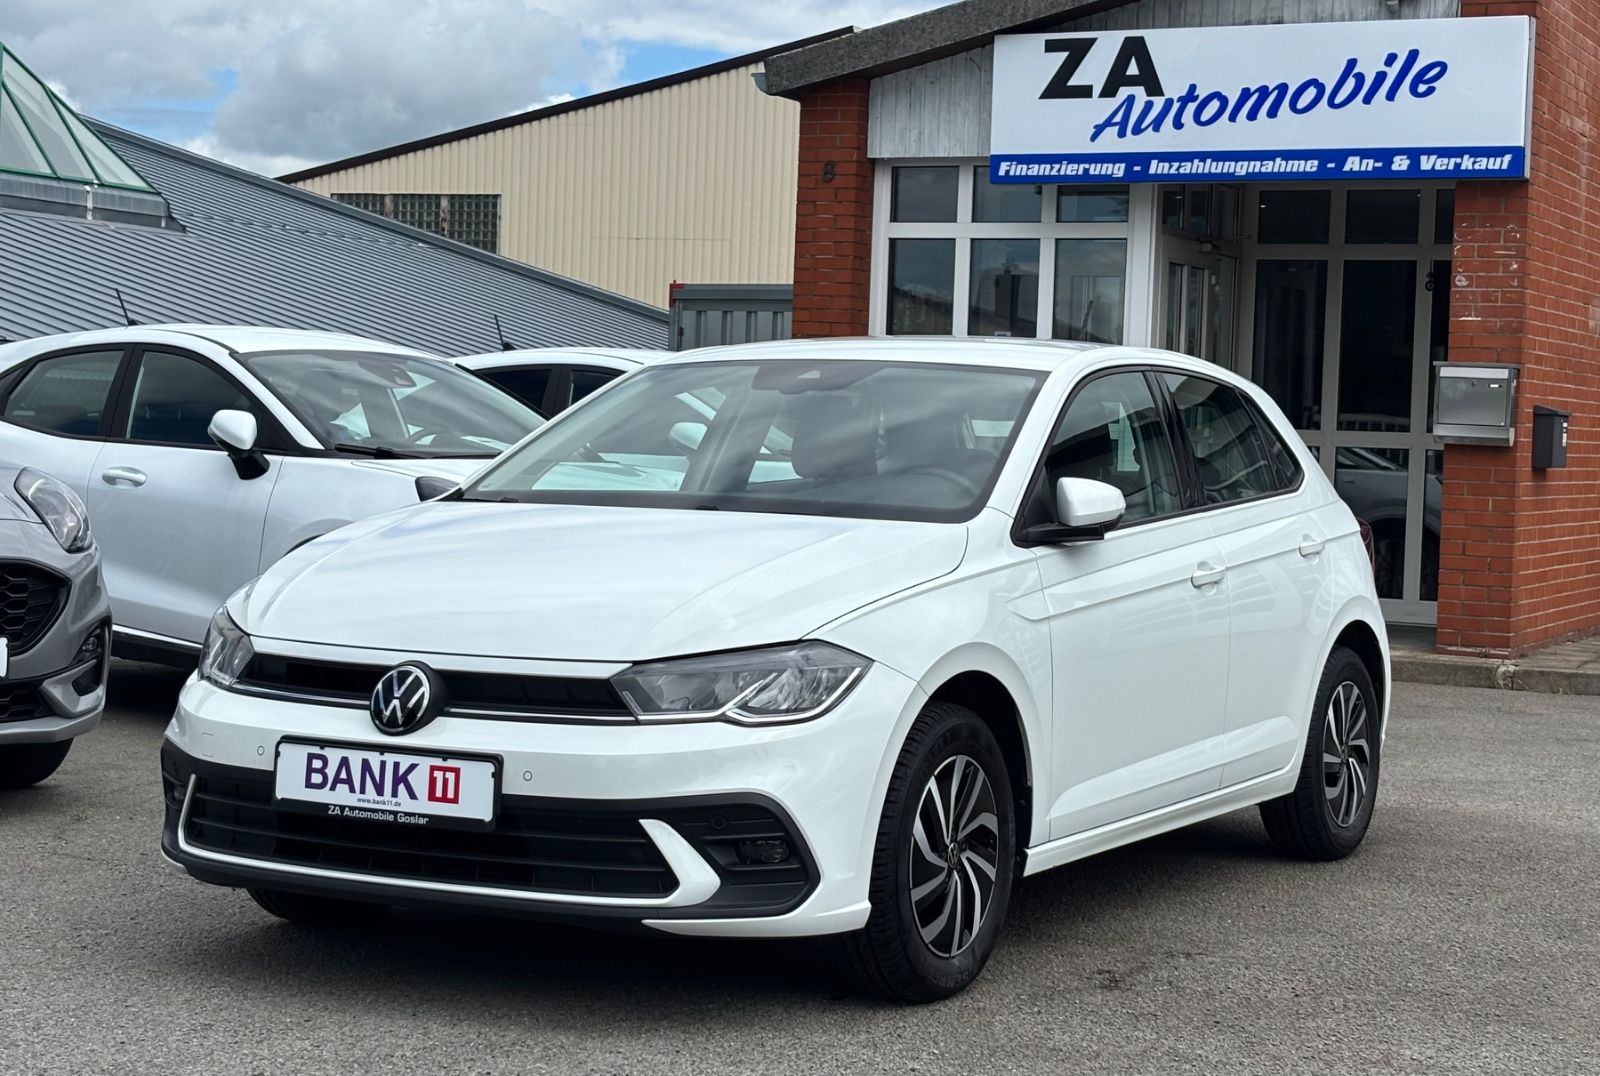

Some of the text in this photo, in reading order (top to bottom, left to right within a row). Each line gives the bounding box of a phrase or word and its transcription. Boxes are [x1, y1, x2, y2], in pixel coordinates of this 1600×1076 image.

[1038, 36, 1165, 100] ZA
[1090, 48, 1448, 143] Automobile
[998, 161, 1126, 177] Finanzierung
[1148, 157, 1318, 176] Inzahlungnahme
[1343, 156, 1382, 171] An-
[1391, 155, 1410, 171] &
[1419, 154, 1512, 171] Verkauf
[304, 752, 456, 801] BANK 11
[328, 805, 429, 825] ZA Automobile Goslar
[357, 798, 402, 807] www.bank11.de
